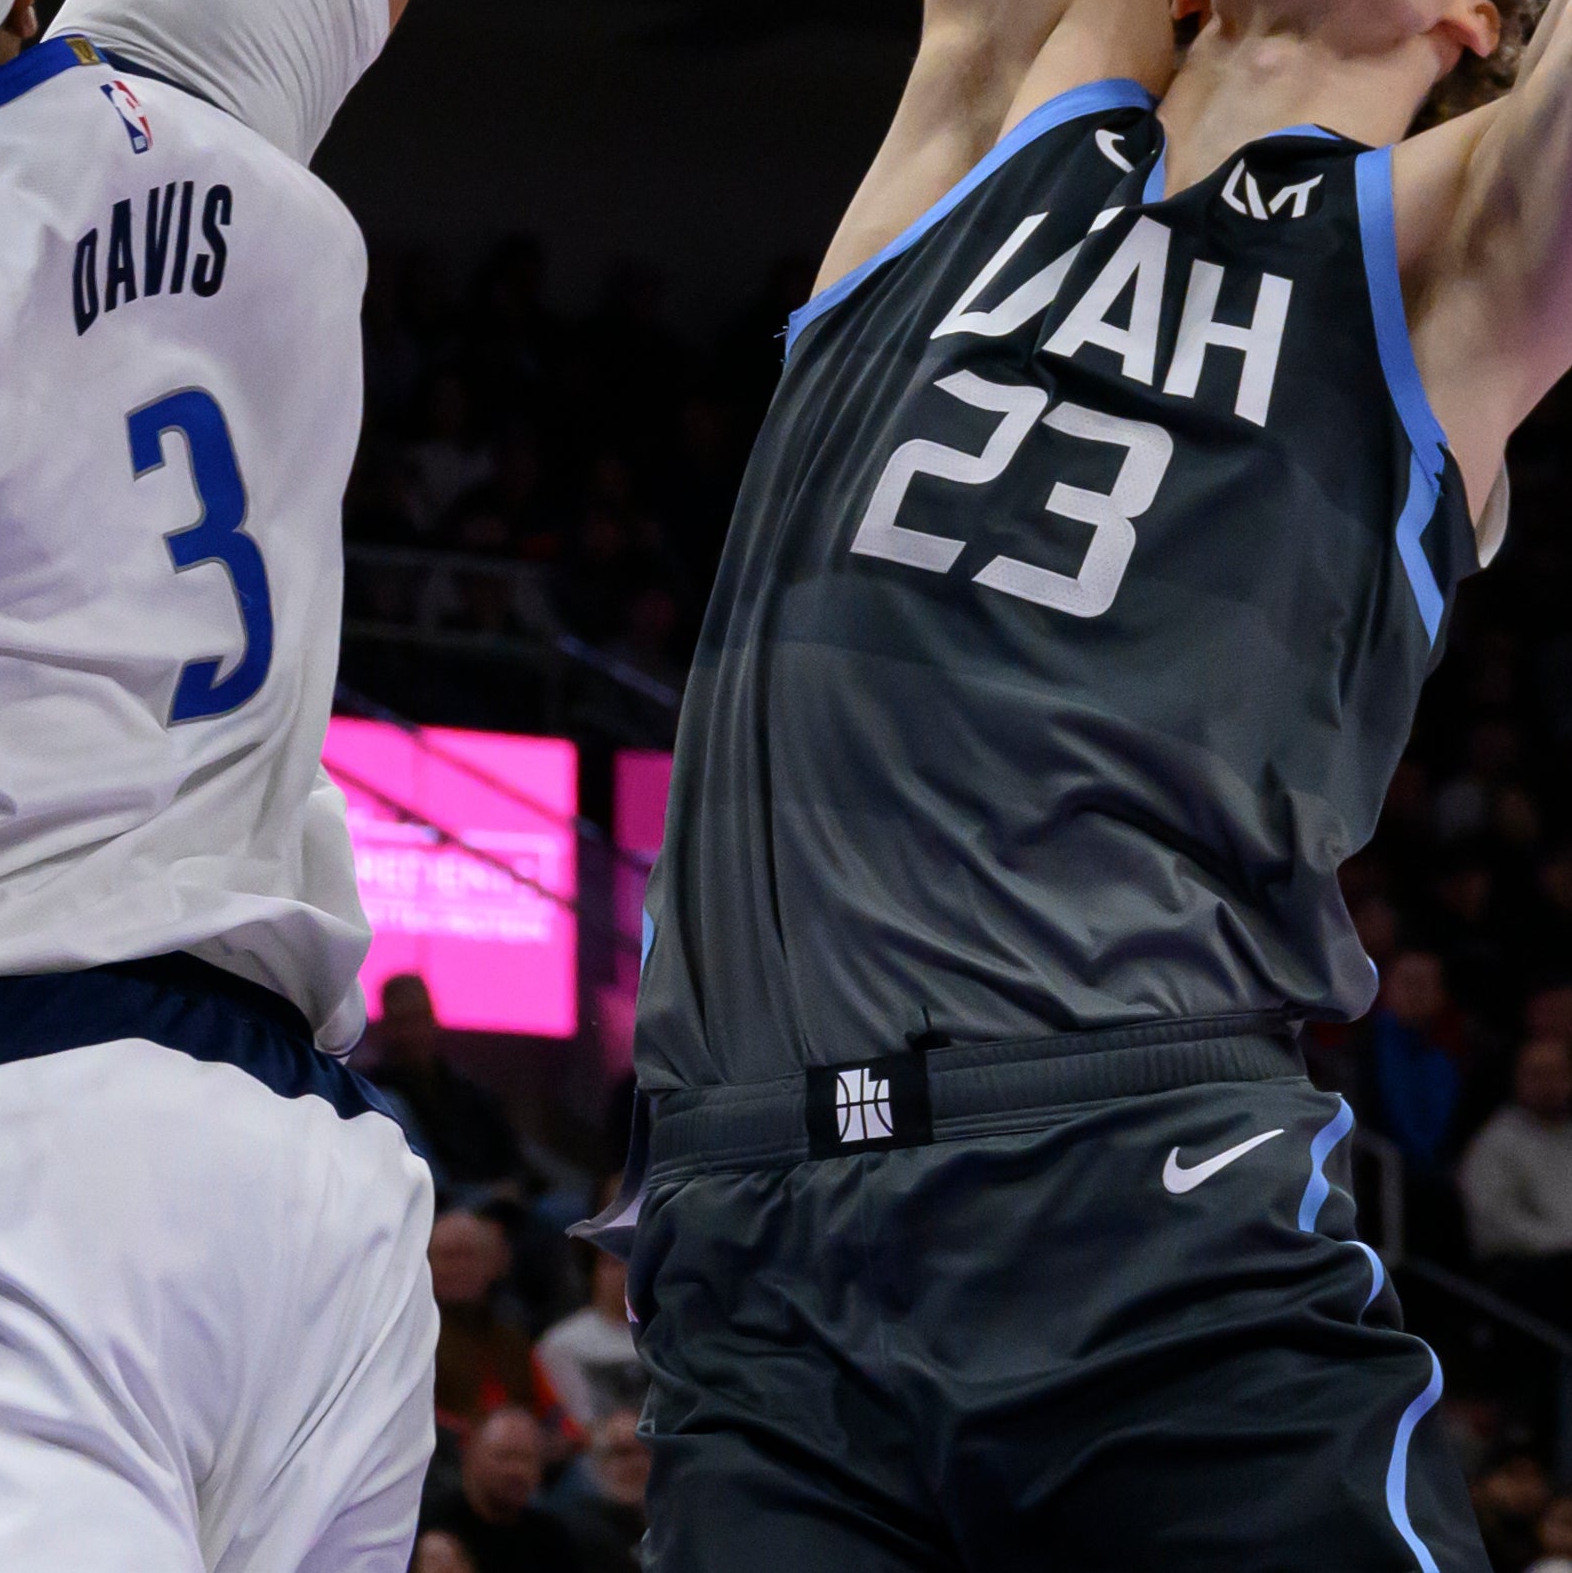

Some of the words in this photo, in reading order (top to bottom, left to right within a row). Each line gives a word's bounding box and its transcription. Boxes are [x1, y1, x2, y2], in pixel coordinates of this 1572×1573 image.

[72, 180, 233, 336] DAVIS
[930, 205, 1294, 428] UAH
[126, 385, 275, 727] 3
[849, 369, 1174, 618] 23
